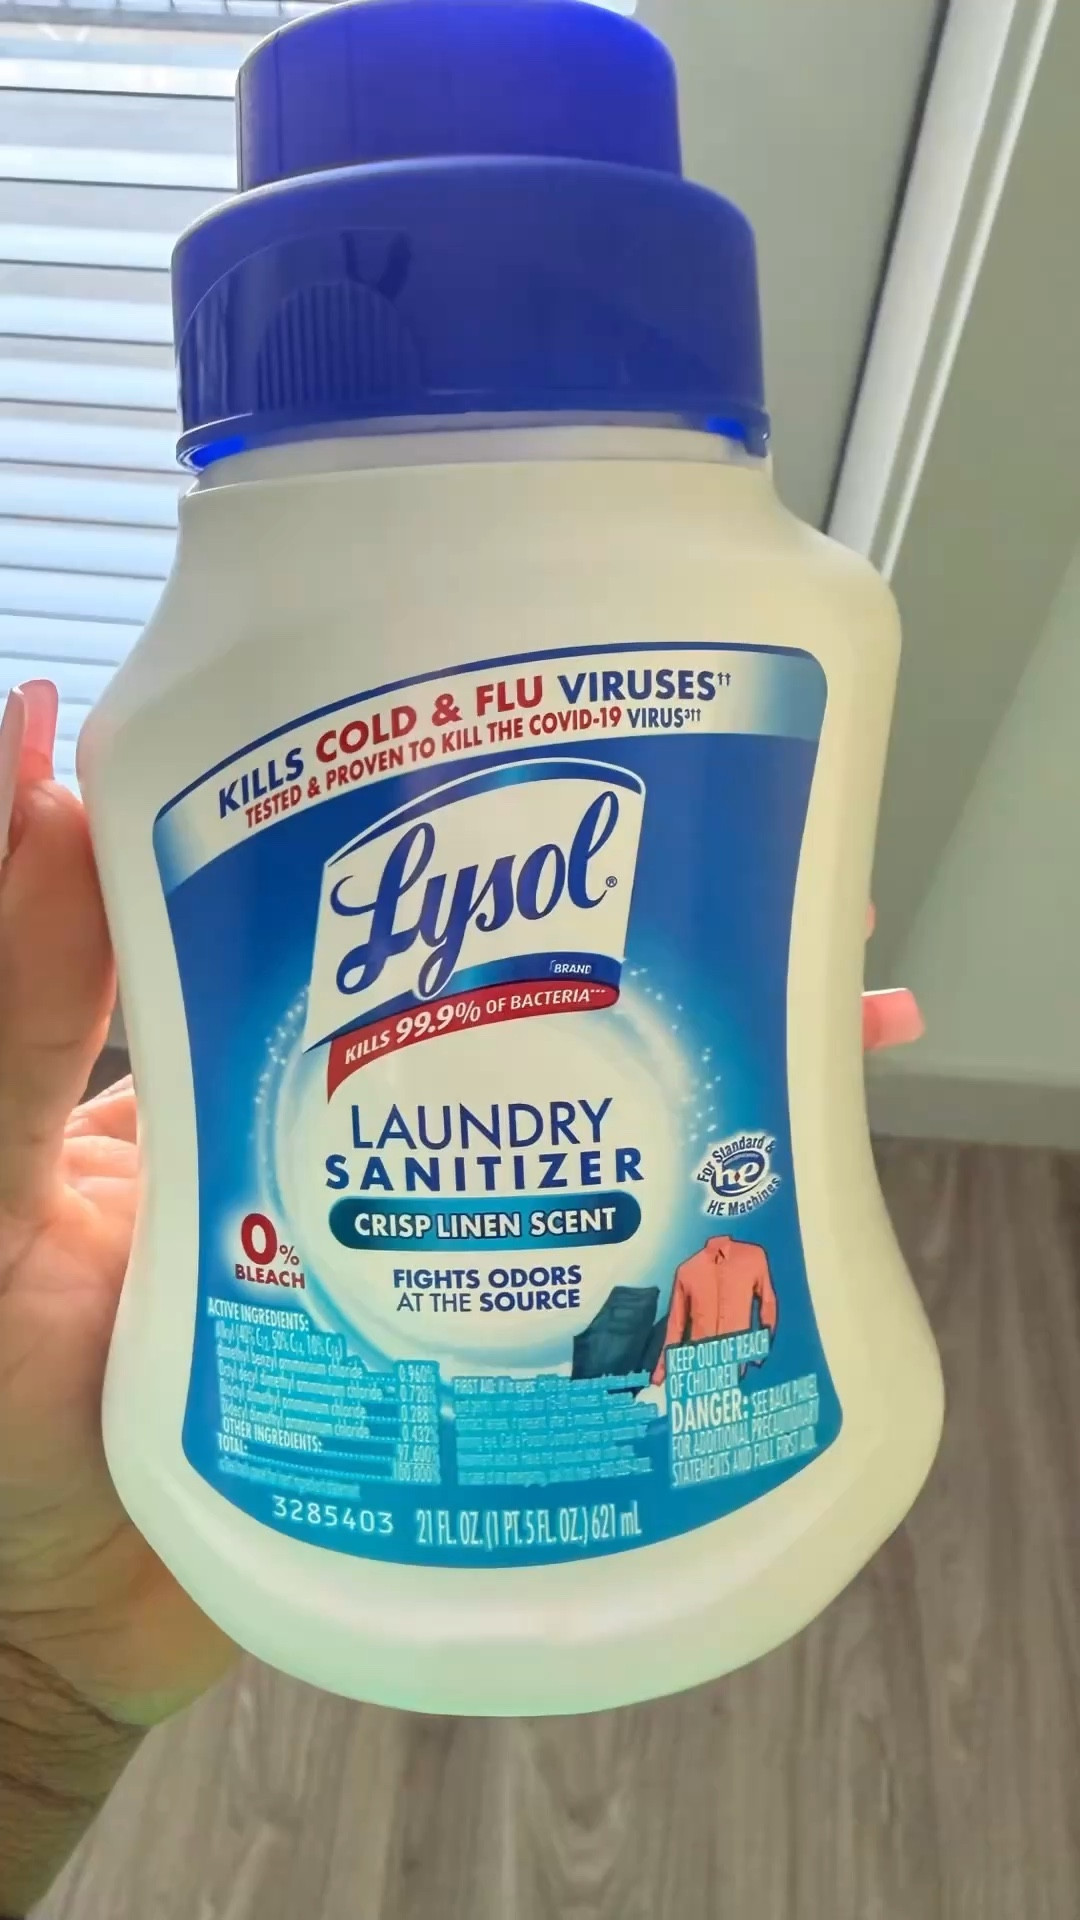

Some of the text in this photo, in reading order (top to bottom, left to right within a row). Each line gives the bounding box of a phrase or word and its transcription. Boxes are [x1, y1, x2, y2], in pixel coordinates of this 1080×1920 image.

[219, 747, 304, 819] KILLS
[316, 705, 417, 763] COLD
[432, 693, 462, 727] &
[476, 675, 543, 716] FLU
[245, 784, 302, 828] TESTED
[307, 776, 321, 799] &
[326, 745, 403, 791] PROVEN
[409, 736, 435, 762] TO
[442, 725, 483, 754] KILL
[487, 717, 523, 743] THE
[529, 706, 622, 736] COVID-19
[554, 962, 592, 975] BRAND
[345, 1030, 390, 1064] KILLS
[396, 1000, 480, 1043] 99.9%
[486, 998, 506, 1014] OF
[351, 1097, 613, 1150] LAUNDRY
[325, 1147, 644, 1192] SANITIZER
[697, 1161, 715, 1182] For
[712, 1136, 766, 1163] Standard
[707, 1177, 780, 1216] HE Machines
[354, 1207, 616, 1238] CRISP LINEN SCENT
[235, 1264, 305, 1289] BLEACH
[393, 1265, 582, 1289] FIGHTS ODORS
[208, 1297, 309, 1332] ACTIVE INGREDIENTS:
[396, 1289, 580, 1312] AT THE SOURCE
[667, 1346, 695, 1372] KEEP
[697, 1340, 719, 1368] OUT
[721, 1337, 734, 1363] OF
[670, 1373, 684, 1399] OF
[672, 1388, 748, 1434] DANGER:
[223, 1418, 251, 1443] OTHER
[254, 1429, 322, 1452] INGREDIENTS:
[273, 1495, 394, 1534] 3285403
[417, 1509, 432, 1544] 21
[438, 1510, 456, 1544] FL.
[460, 1511, 482, 1545] OZ.
[525, 1510, 535, 1544] 5
[538, 1509, 556, 1544] FL.
[592, 1503, 615, 1540] 621
[621, 1500, 641, 1536] mL
